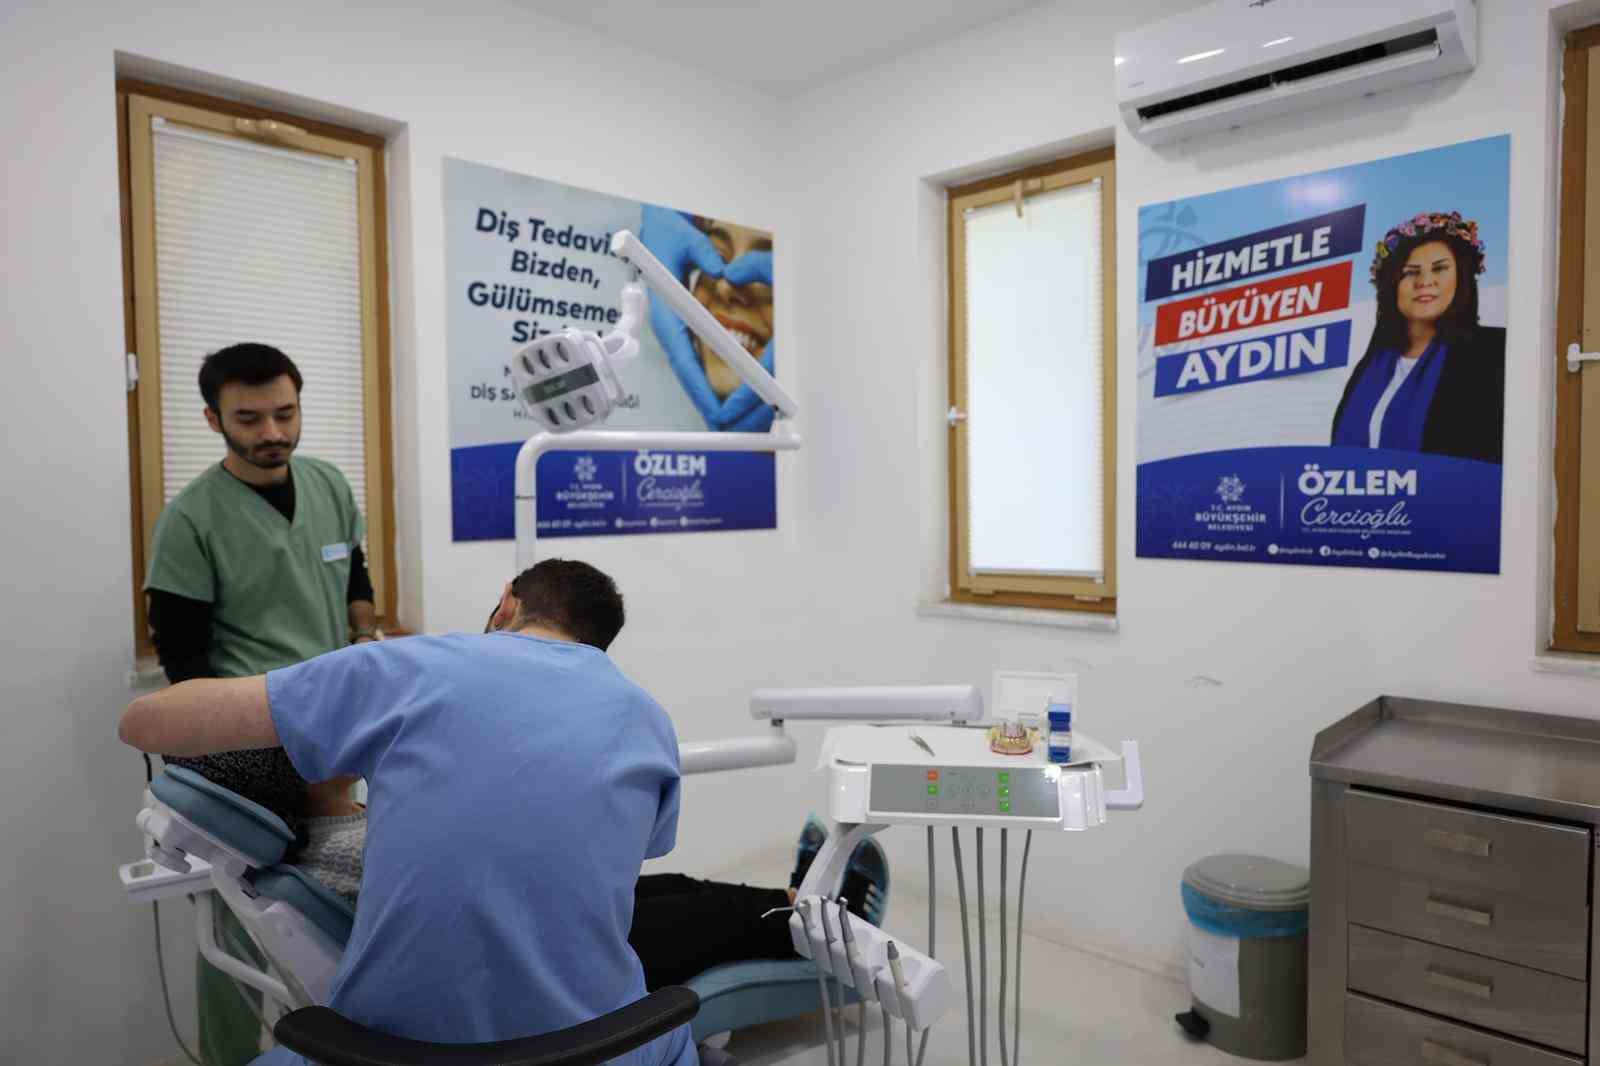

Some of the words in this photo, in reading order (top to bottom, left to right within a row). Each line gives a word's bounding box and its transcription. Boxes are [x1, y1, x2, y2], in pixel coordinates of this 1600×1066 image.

[475, 207, 521, 242] Diş
[528, 217, 614, 256] Tedavi
[510, 249, 601, 290] Bizden,
[1171, 226, 1331, 292] HİZMETLE
[467, 281, 624, 325] Gülümseme
[1177, 281, 1323, 339] BÜYÜYEN
[1175, 327, 1327, 389] AYDIN
[634, 448, 707, 477] ÖZLEM
[1298, 463, 1417, 496] ÖZLEM
[1194, 511, 1267, 524] BÜYÜKŞEHİR
[1300, 497, 1412, 540] Cercioğlu
